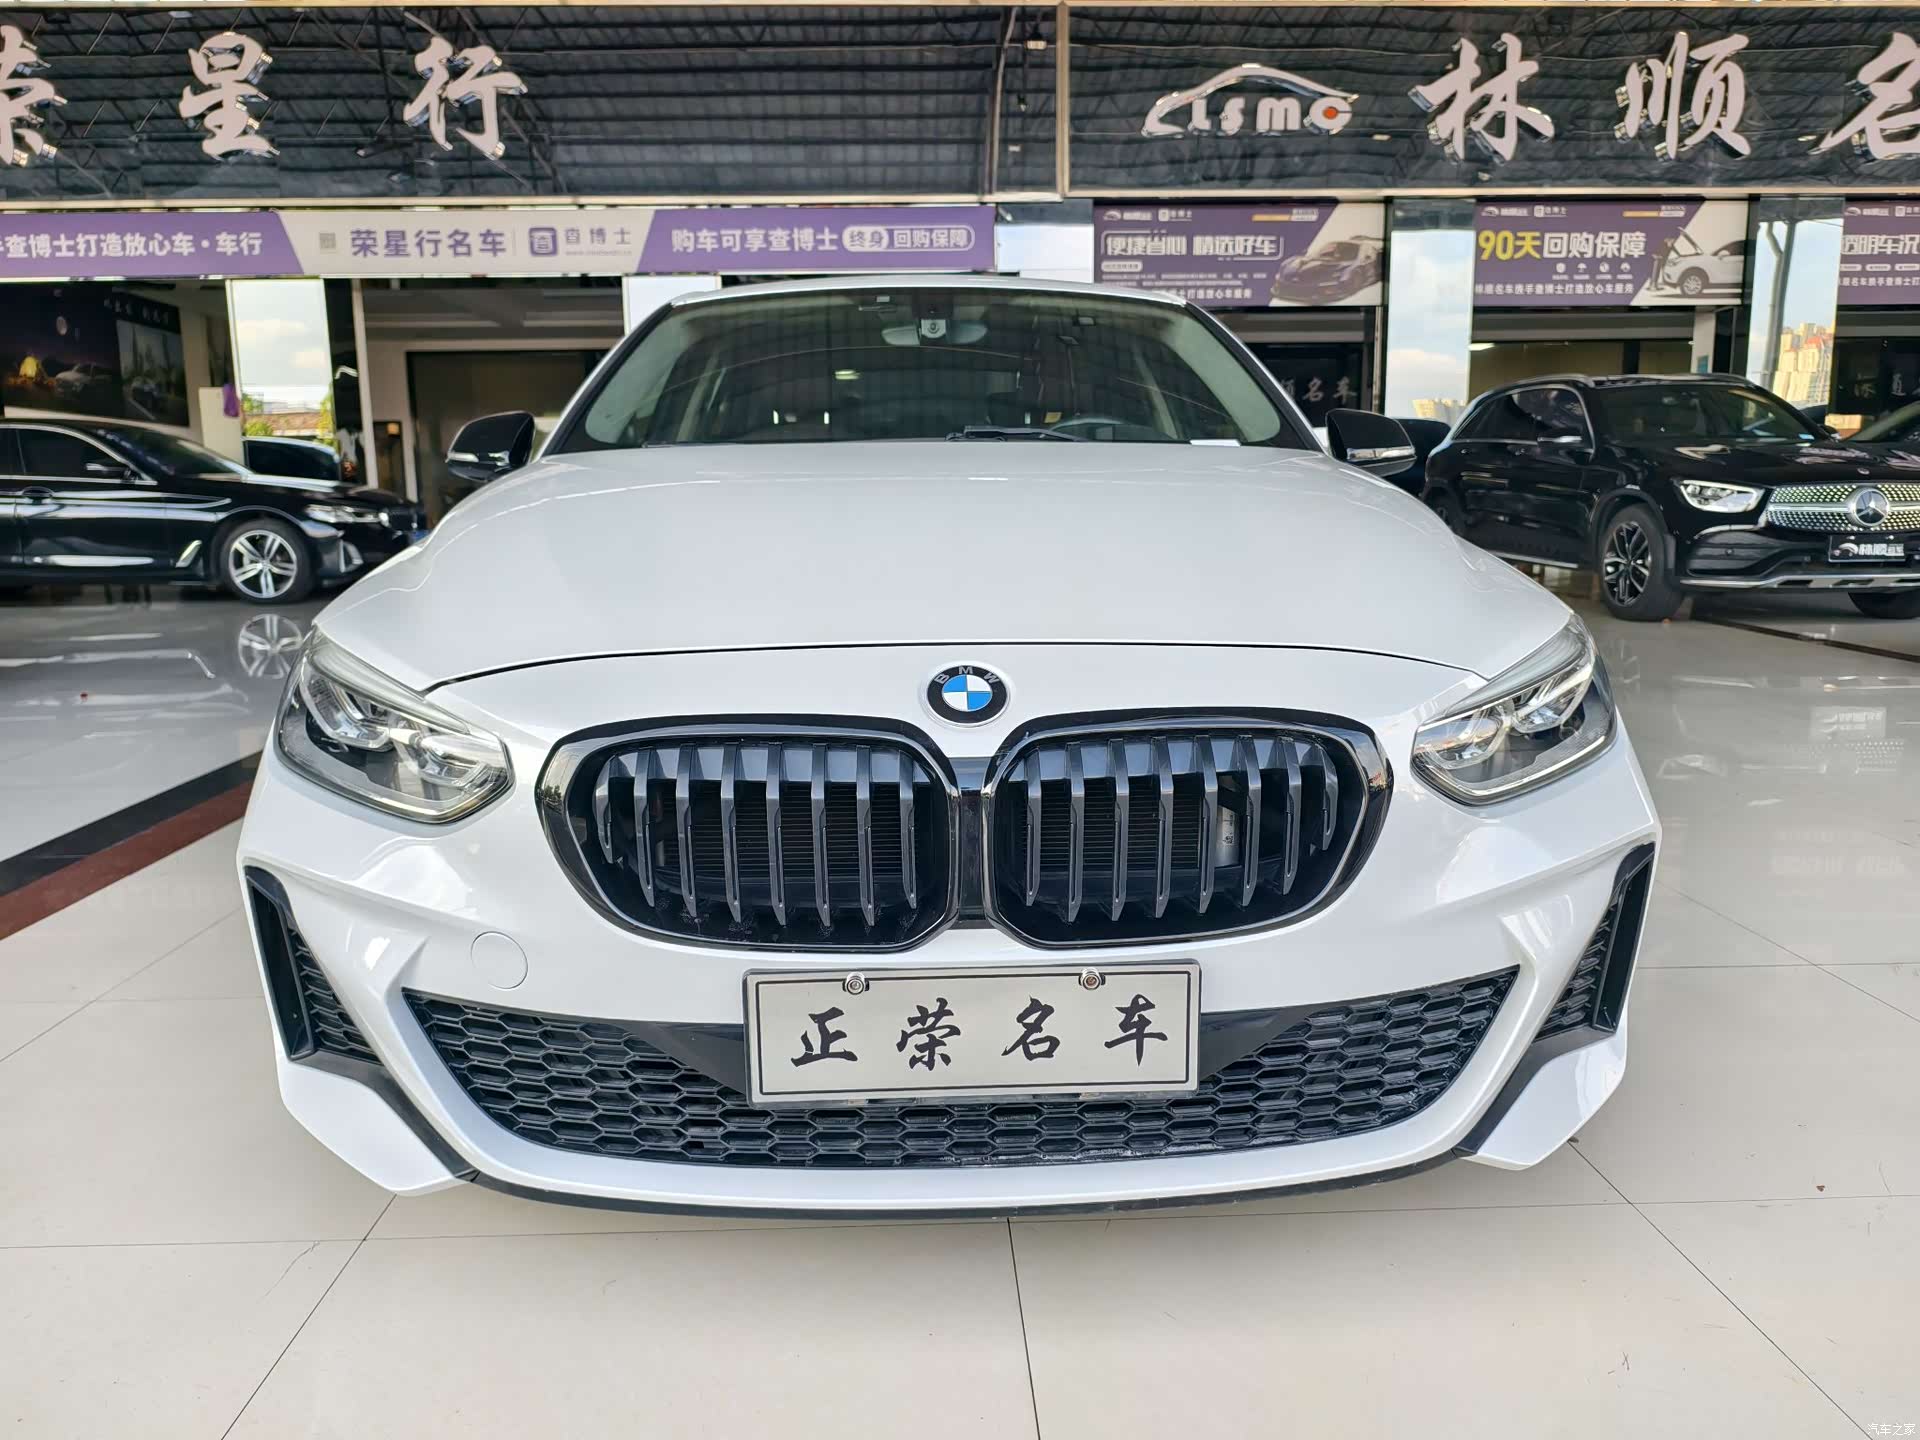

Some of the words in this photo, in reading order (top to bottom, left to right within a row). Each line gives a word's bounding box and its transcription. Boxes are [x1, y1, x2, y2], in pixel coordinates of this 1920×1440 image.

[350, 228, 507, 258] 荣星行名车
[563, 227, 633, 246] 查博士
[671, 228, 839, 252] 购车可享查博士
[848, 229, 885, 249] 终身
[892, 228, 970, 249] 回购保障
[1106, 235, 1187, 256] 便捷省心
[1193, 235, 1277, 256] 精选好车
[1478, 230, 1647, 260] 90天回购保障
[934, 665, 1001, 685] BMW
[790, 994, 1169, 1071] 正荣名车
